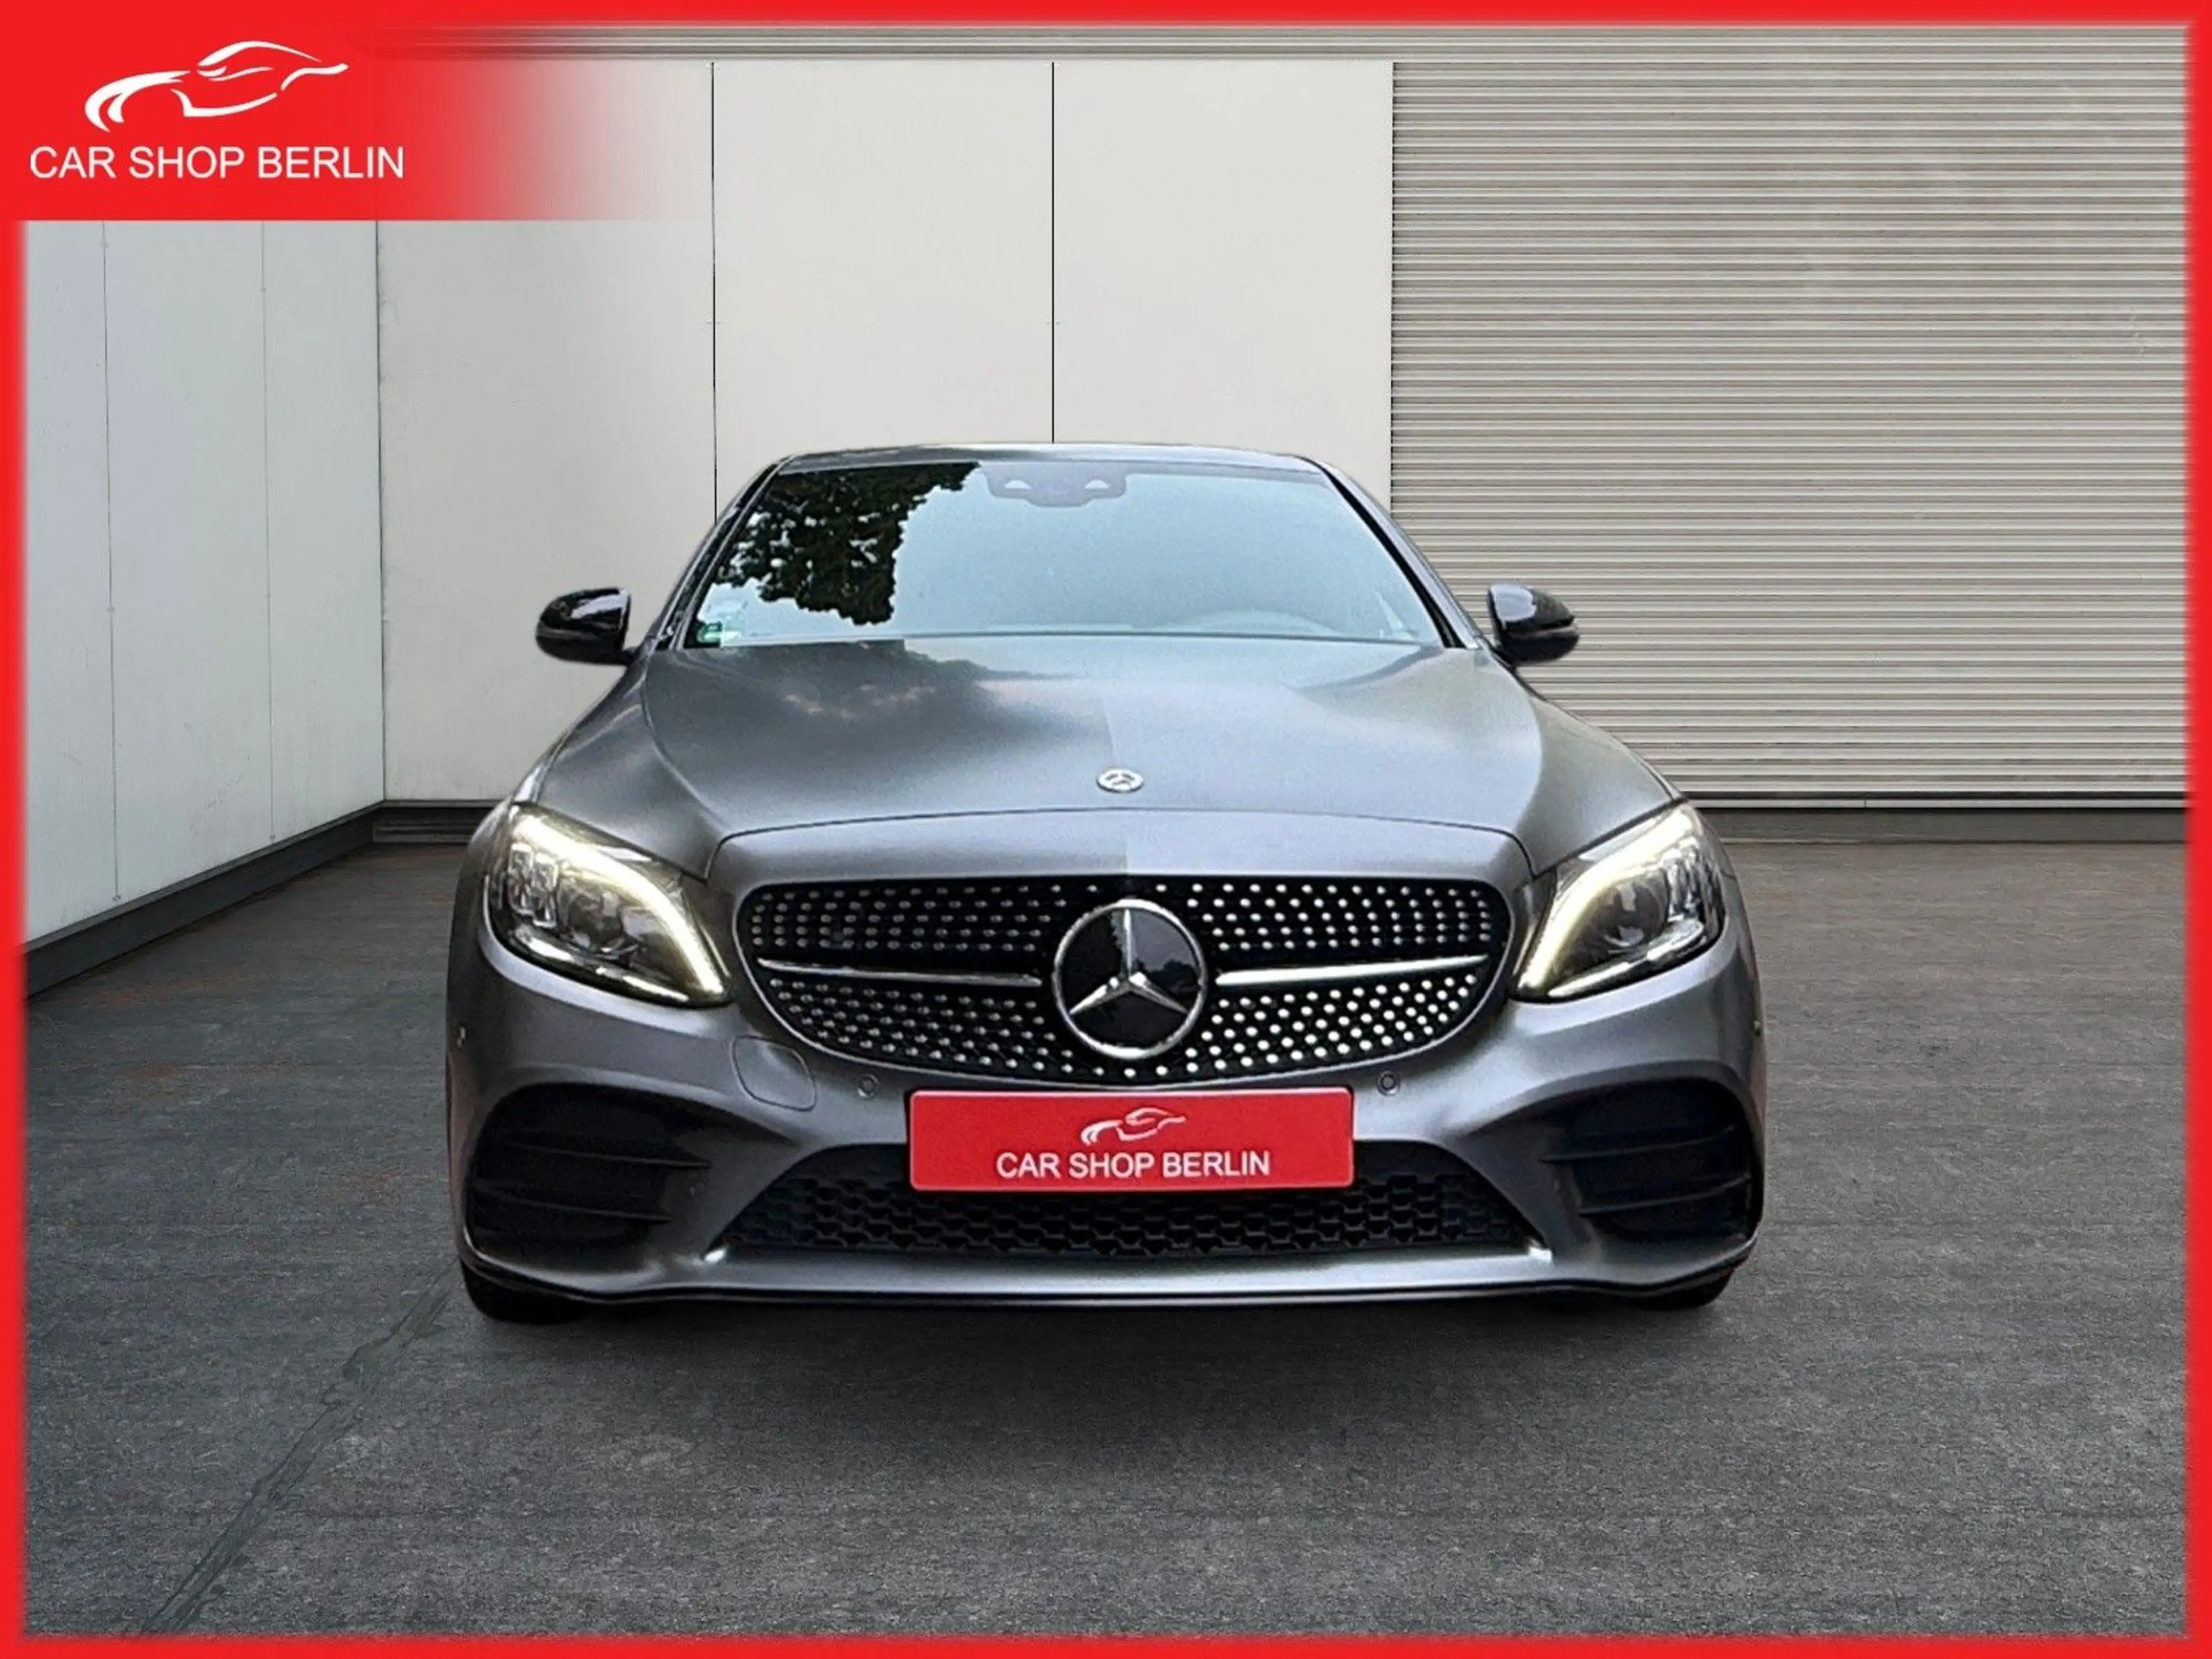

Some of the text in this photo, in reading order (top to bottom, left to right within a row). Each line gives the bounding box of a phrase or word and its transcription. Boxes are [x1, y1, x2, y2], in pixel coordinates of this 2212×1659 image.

[997, 1150, 1271, 1179] CAR SHOP BERLIN
